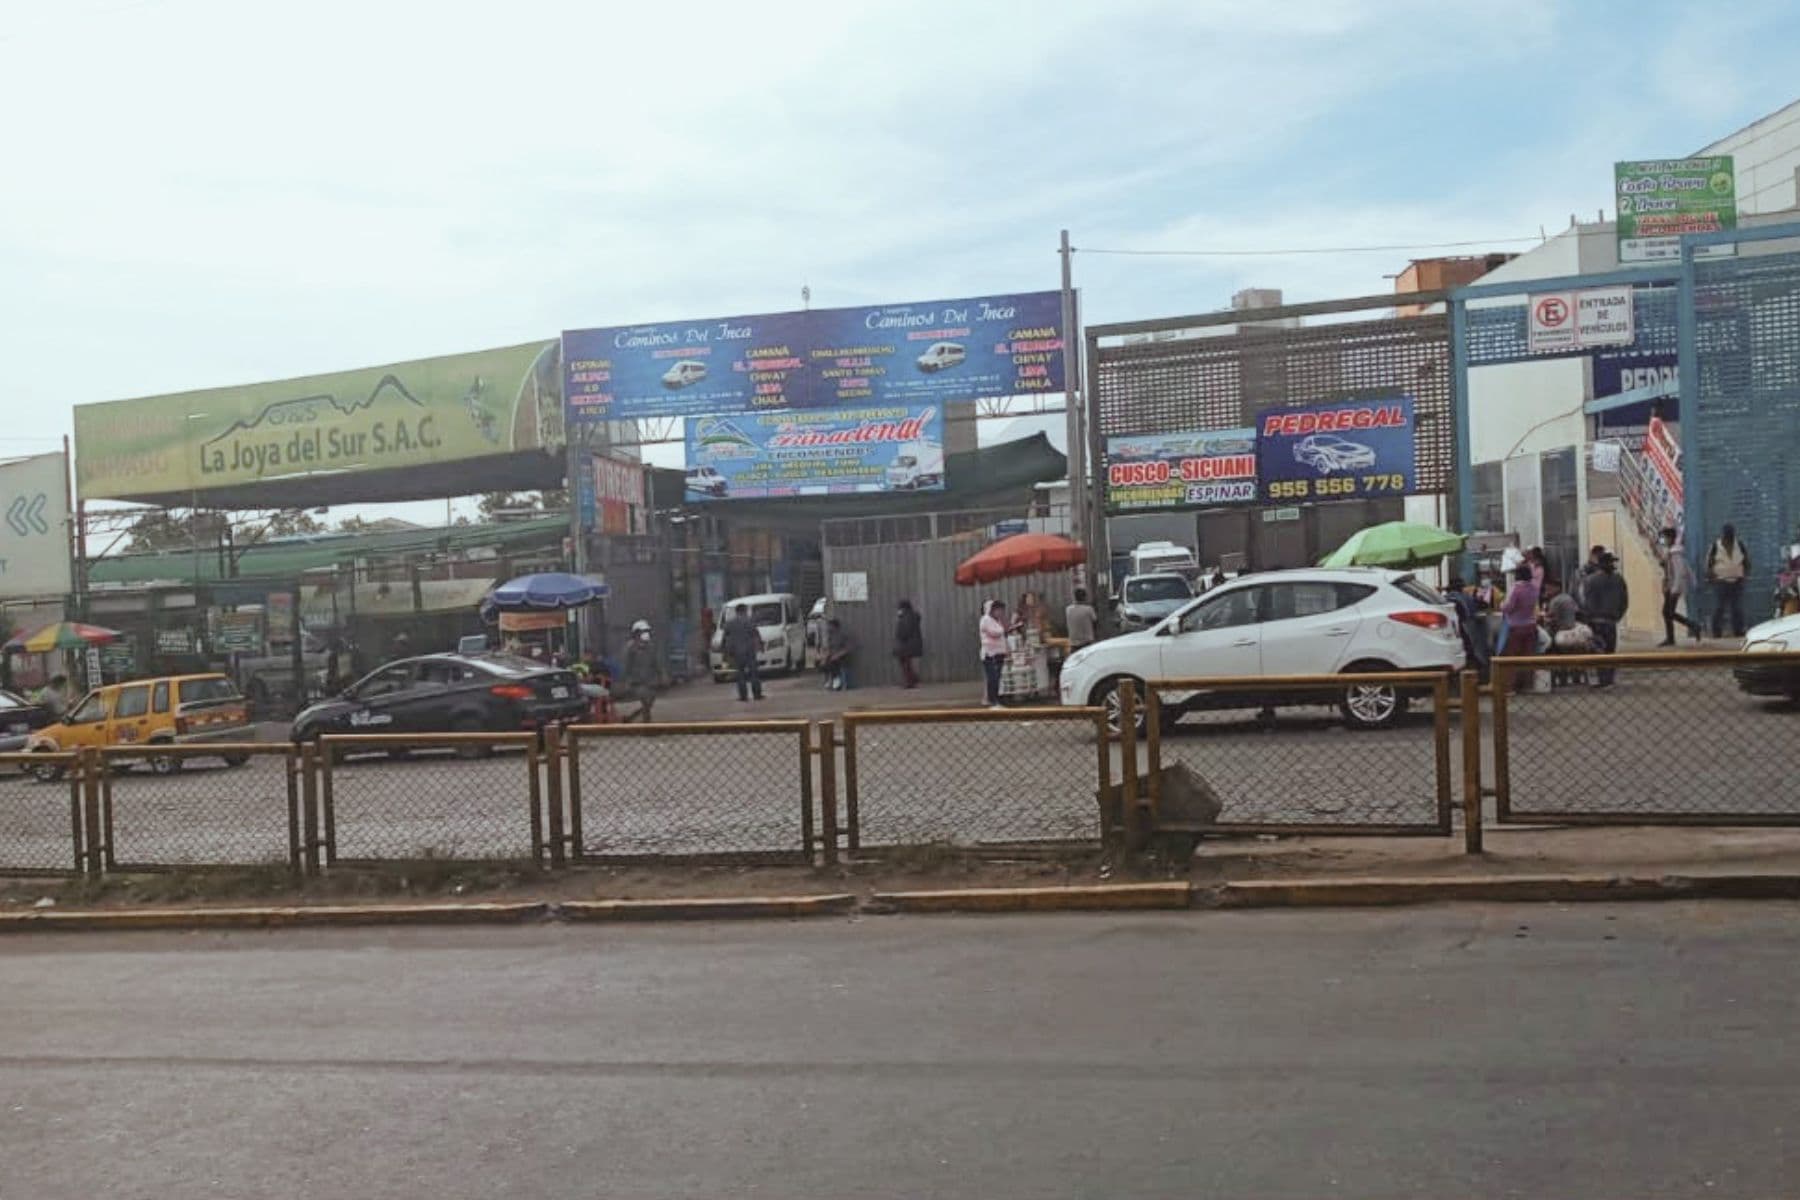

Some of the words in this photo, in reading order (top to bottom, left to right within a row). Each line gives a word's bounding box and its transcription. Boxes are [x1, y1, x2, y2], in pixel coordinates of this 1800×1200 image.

[1580, 296, 1626, 309] ENTRADA
[865, 311, 934, 328] Caminos
[1597, 310, 1609, 320] DE
[614, 331, 678, 349] Caminos
[1263, 406, 1407, 437] PEDREGAL
[200, 444, 226, 474] La
[231, 440, 281, 476] Joya
[287, 427, 321, 463] del
[328, 426, 366, 459] Sur
[372, 414, 442, 454] S.A.C.
[1109, 460, 1170, 486] CUSCO
[1180, 455, 1256, 480] SICUANI
[1187, 484, 1254, 501] ESPINAR
[1269, 481, 1308, 497] 955
[1315, 478, 1355, 494] 556
[1363, 474, 1404, 491] 778
